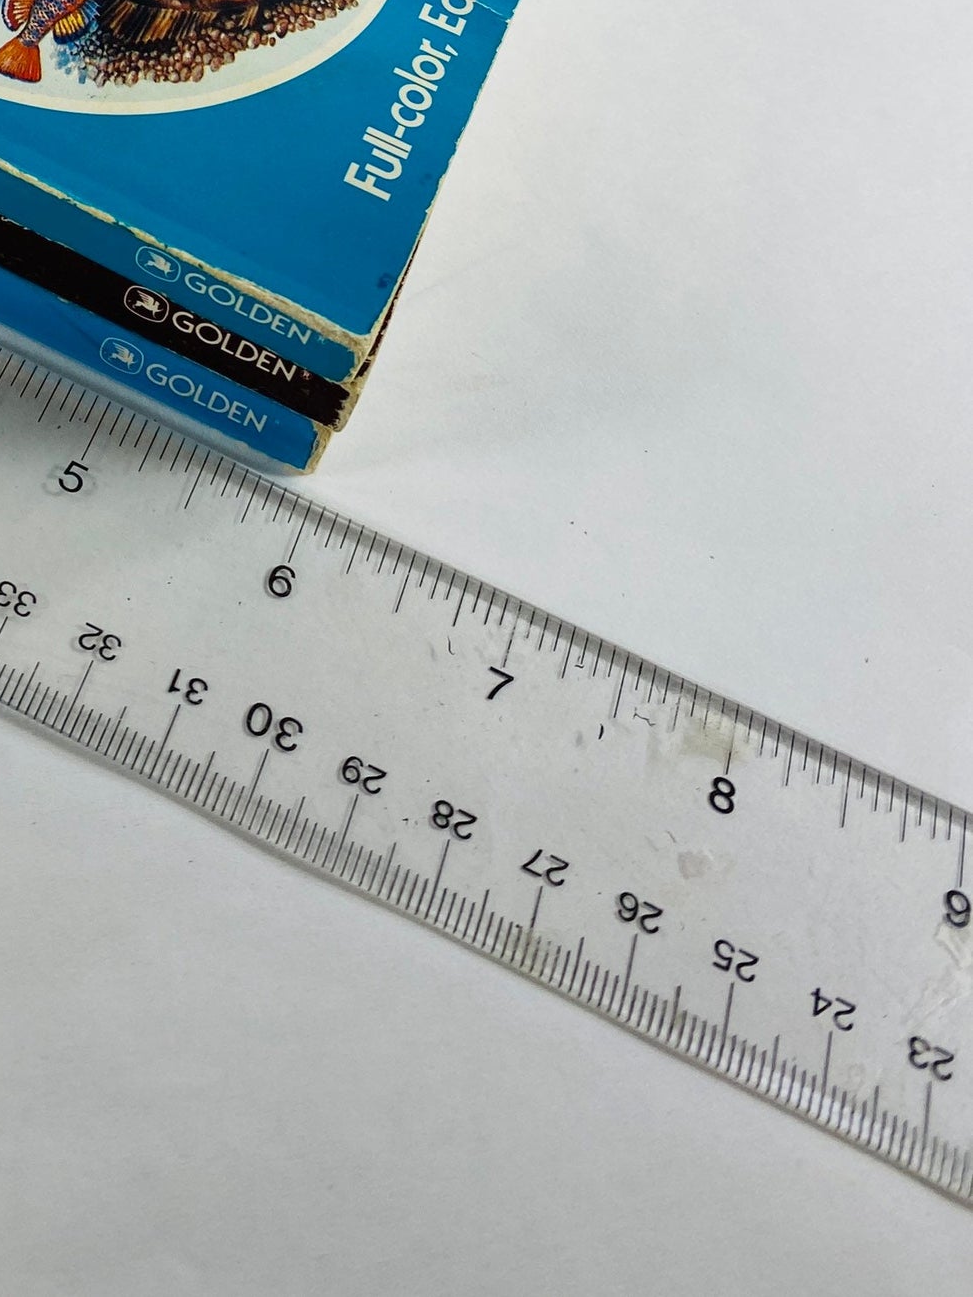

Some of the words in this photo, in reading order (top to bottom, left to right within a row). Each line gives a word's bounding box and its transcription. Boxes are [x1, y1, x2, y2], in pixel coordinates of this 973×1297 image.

[343, 39, 458, 202] Full-color,
[78, 622, 122, 661] 32
[59, 460, 89, 493] 5
[267, 564, 296, 598] 6
[485, 666, 514, 701] 7
[709, 776, 736, 816] 8
[944, 889, 971, 928] 9
[168, 668, 208, 705] 31
[246, 703, 303, 751] 30
[342, 756, 387, 794] 29
[430, 799, 477, 840] 28
[521, 847, 569, 887] 27
[616, 891, 664, 935] 26
[712, 938, 760, 983] 25
[810, 988, 856, 1032] 24
[907, 1035, 954, 1081] 23
